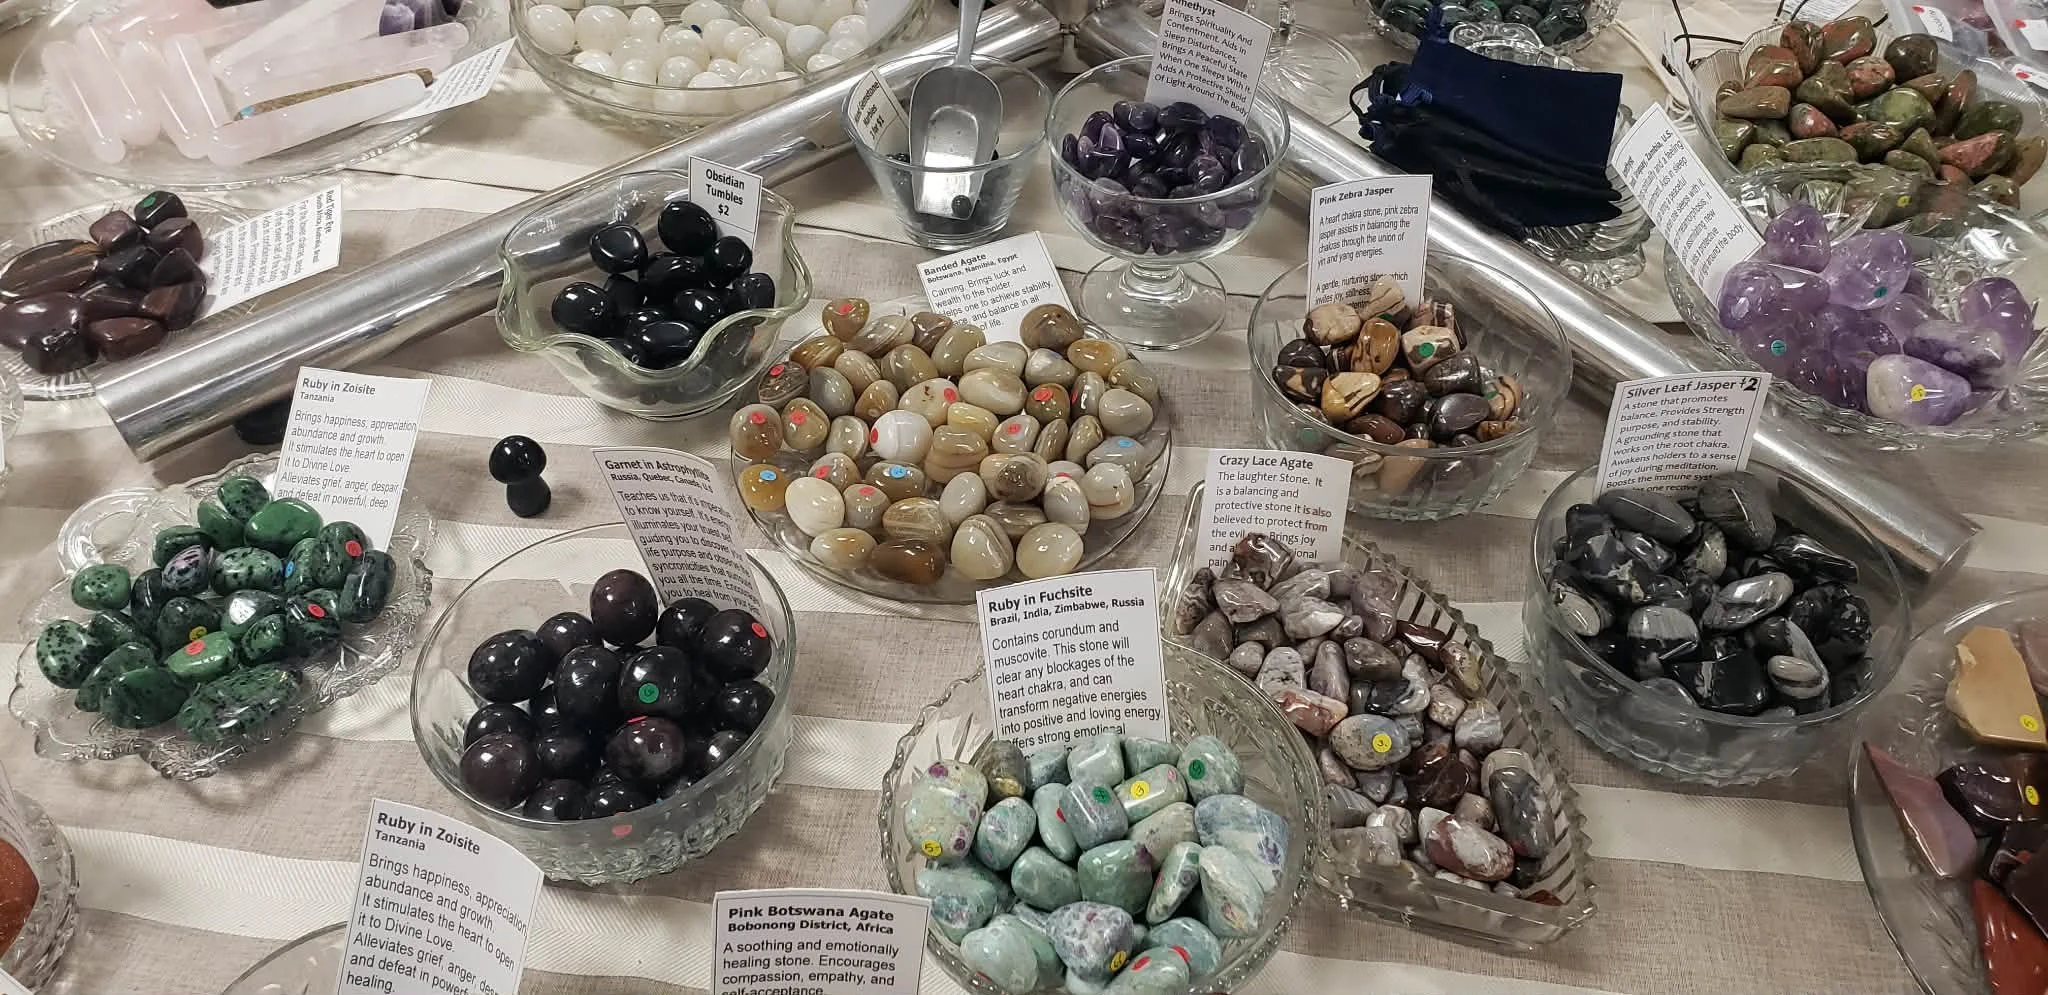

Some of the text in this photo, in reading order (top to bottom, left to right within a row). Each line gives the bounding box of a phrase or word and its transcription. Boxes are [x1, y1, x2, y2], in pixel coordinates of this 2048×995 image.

[1164, 30, 1185, 42] Sleep
[1169, 8, 1253, 46] Brings Spirituality And
[1222, 39, 1238, 51] Aids
[1162, 41, 1186, 55] Brings
[1196, 51, 1227, 71] Peaceful
[1229, 66, 1247, 79] State
[1160, 52, 1182, 65] When
[1184, 60, 1199, 69] One
[1201, 65, 1224, 81] Sleeps
[1227, 75, 1243, 89] With
[1157, 63, 1176, 74] Adds
[1186, 71, 1223, 91] Protective
[1225, 86, 1246, 103] Shield
[1166, 75, 1185, 87] Light
[1187, 83, 1214, 98] Around
[1216, 94, 1230, 106] The
[706, 169, 745, 190] Obsidian
[706, 184, 743, 205] Tumbles
[1320, 187, 1394, 206] Pink Zebra Jasper
[718, 204, 729, 216] $2
[924, 253, 987, 276] Banded Agate
[968, 275, 993, 288] Brings
[994, 269, 1010, 280] luck
[1012, 264, 1026, 275] and
[935, 296, 962, 309] wealth
[963, 293, 971, 301] to
[972, 288, 985, 298] the
[302, 378, 376, 395] Ruby in Zoisite
[1626, 380, 1735, 399] Silver Leaf Jasper
[300, 392, 335, 403] Tanzania
[1632, 400, 1658, 409] stone
[1661, 396, 1679, 406] that
[1681, 395, 1728, 405] promotes
[1620, 406, 1745, 422] balance. Provides Strength
[292, 427, 337, 440] abundance
[340, 432, 355, 442] and
[1620, 418, 1721, 435] purpose, and stability.
[605, 460, 642, 470] Garnet
[645, 460, 654, 469] in
[1219, 455, 1313, 470] Crazy Lace Agate
[611, 473, 641, 482] Russia,
[1218, 472, 1323, 487] The laughter Stone. It
[617, 491, 657, 501] Teaches
[659, 493, 670, 501] us
[1216, 487, 1223, 496] is
[1234, 486, 1278, 498] balancing
[1281, 488, 1299, 498] and
[988, 586, 1093, 613] Ruby in Fuchsite
[990, 597, 1145, 626] Brazil, India, Zimbabwe, Russia
[992, 620, 1119, 651] Contains corundum and
[994, 637, 1130, 668] muscovite. This stone will
[996, 655, 1135, 685] clear any blockages of the
[998, 674, 1112, 702] heart chakra, and can
[1000, 690, 1147, 719] transform negative energies
[375, 830, 426, 850] Tanzania
[377, 813, 481, 855] Ruby in Zoisite
[369, 853, 409, 876] Brings
[413, 864, 472, 899] happiness,
[365, 876, 495, 933] abundance and growth.
[729, 906, 894, 921] Pink Botswana Agate
[358, 912, 454, 952] it to Divine Love.
[728, 920, 894, 935] Bobonong District, Africa
[723, 939, 899, 959] A soothing and emotionally
[724, 955, 896, 972] healing stone. Encourages
[723, 971, 895, 986] compassion, empathy, and
